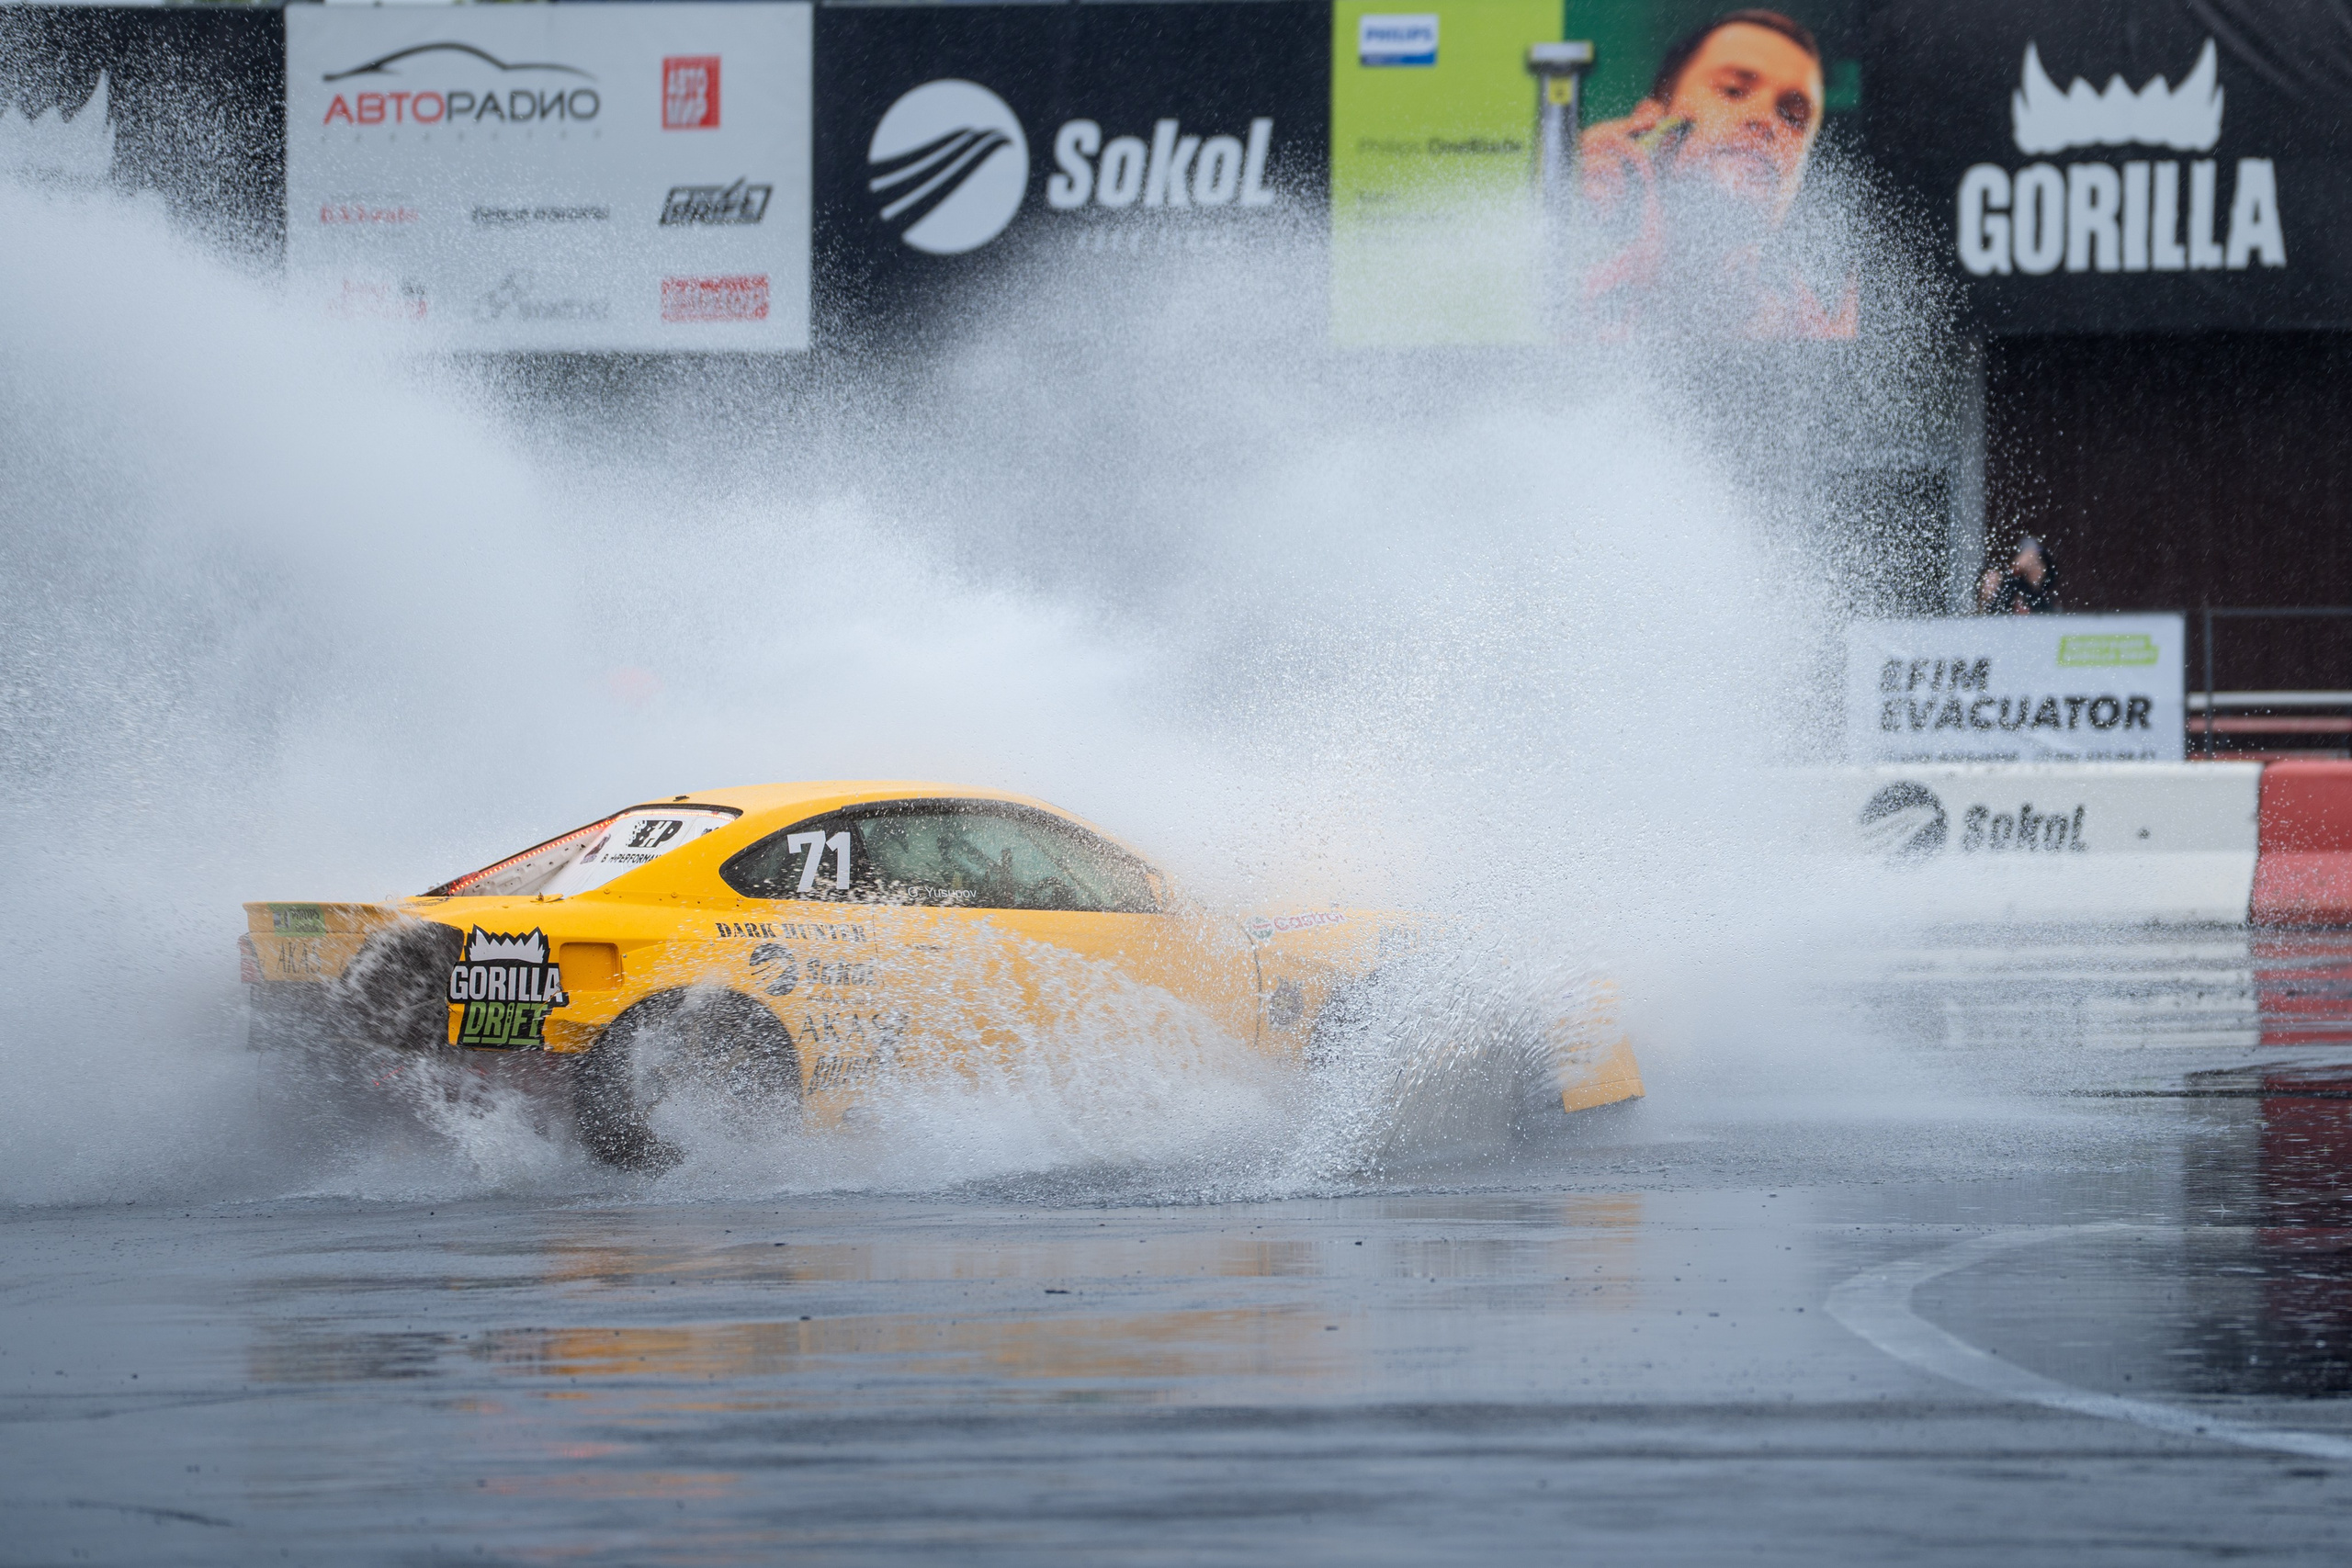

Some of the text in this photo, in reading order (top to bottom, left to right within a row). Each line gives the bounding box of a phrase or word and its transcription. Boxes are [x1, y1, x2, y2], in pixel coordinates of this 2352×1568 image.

[323, 90, 600, 125] АВТОРАДИО
[1957, 157, 2288, 275] GORILLA
[1880, 657, 1993, 694] EFIM
[1881, 694, 2153, 732] EVACUATOR
[786, 830, 851, 892] 71
[924, 886, 978, 899] Yusupov
[715, 921, 867, 943] DARK HUNTER
[449, 965, 563, 1003] GORILLA
[463, 1001, 548, 1045] DRIFT
